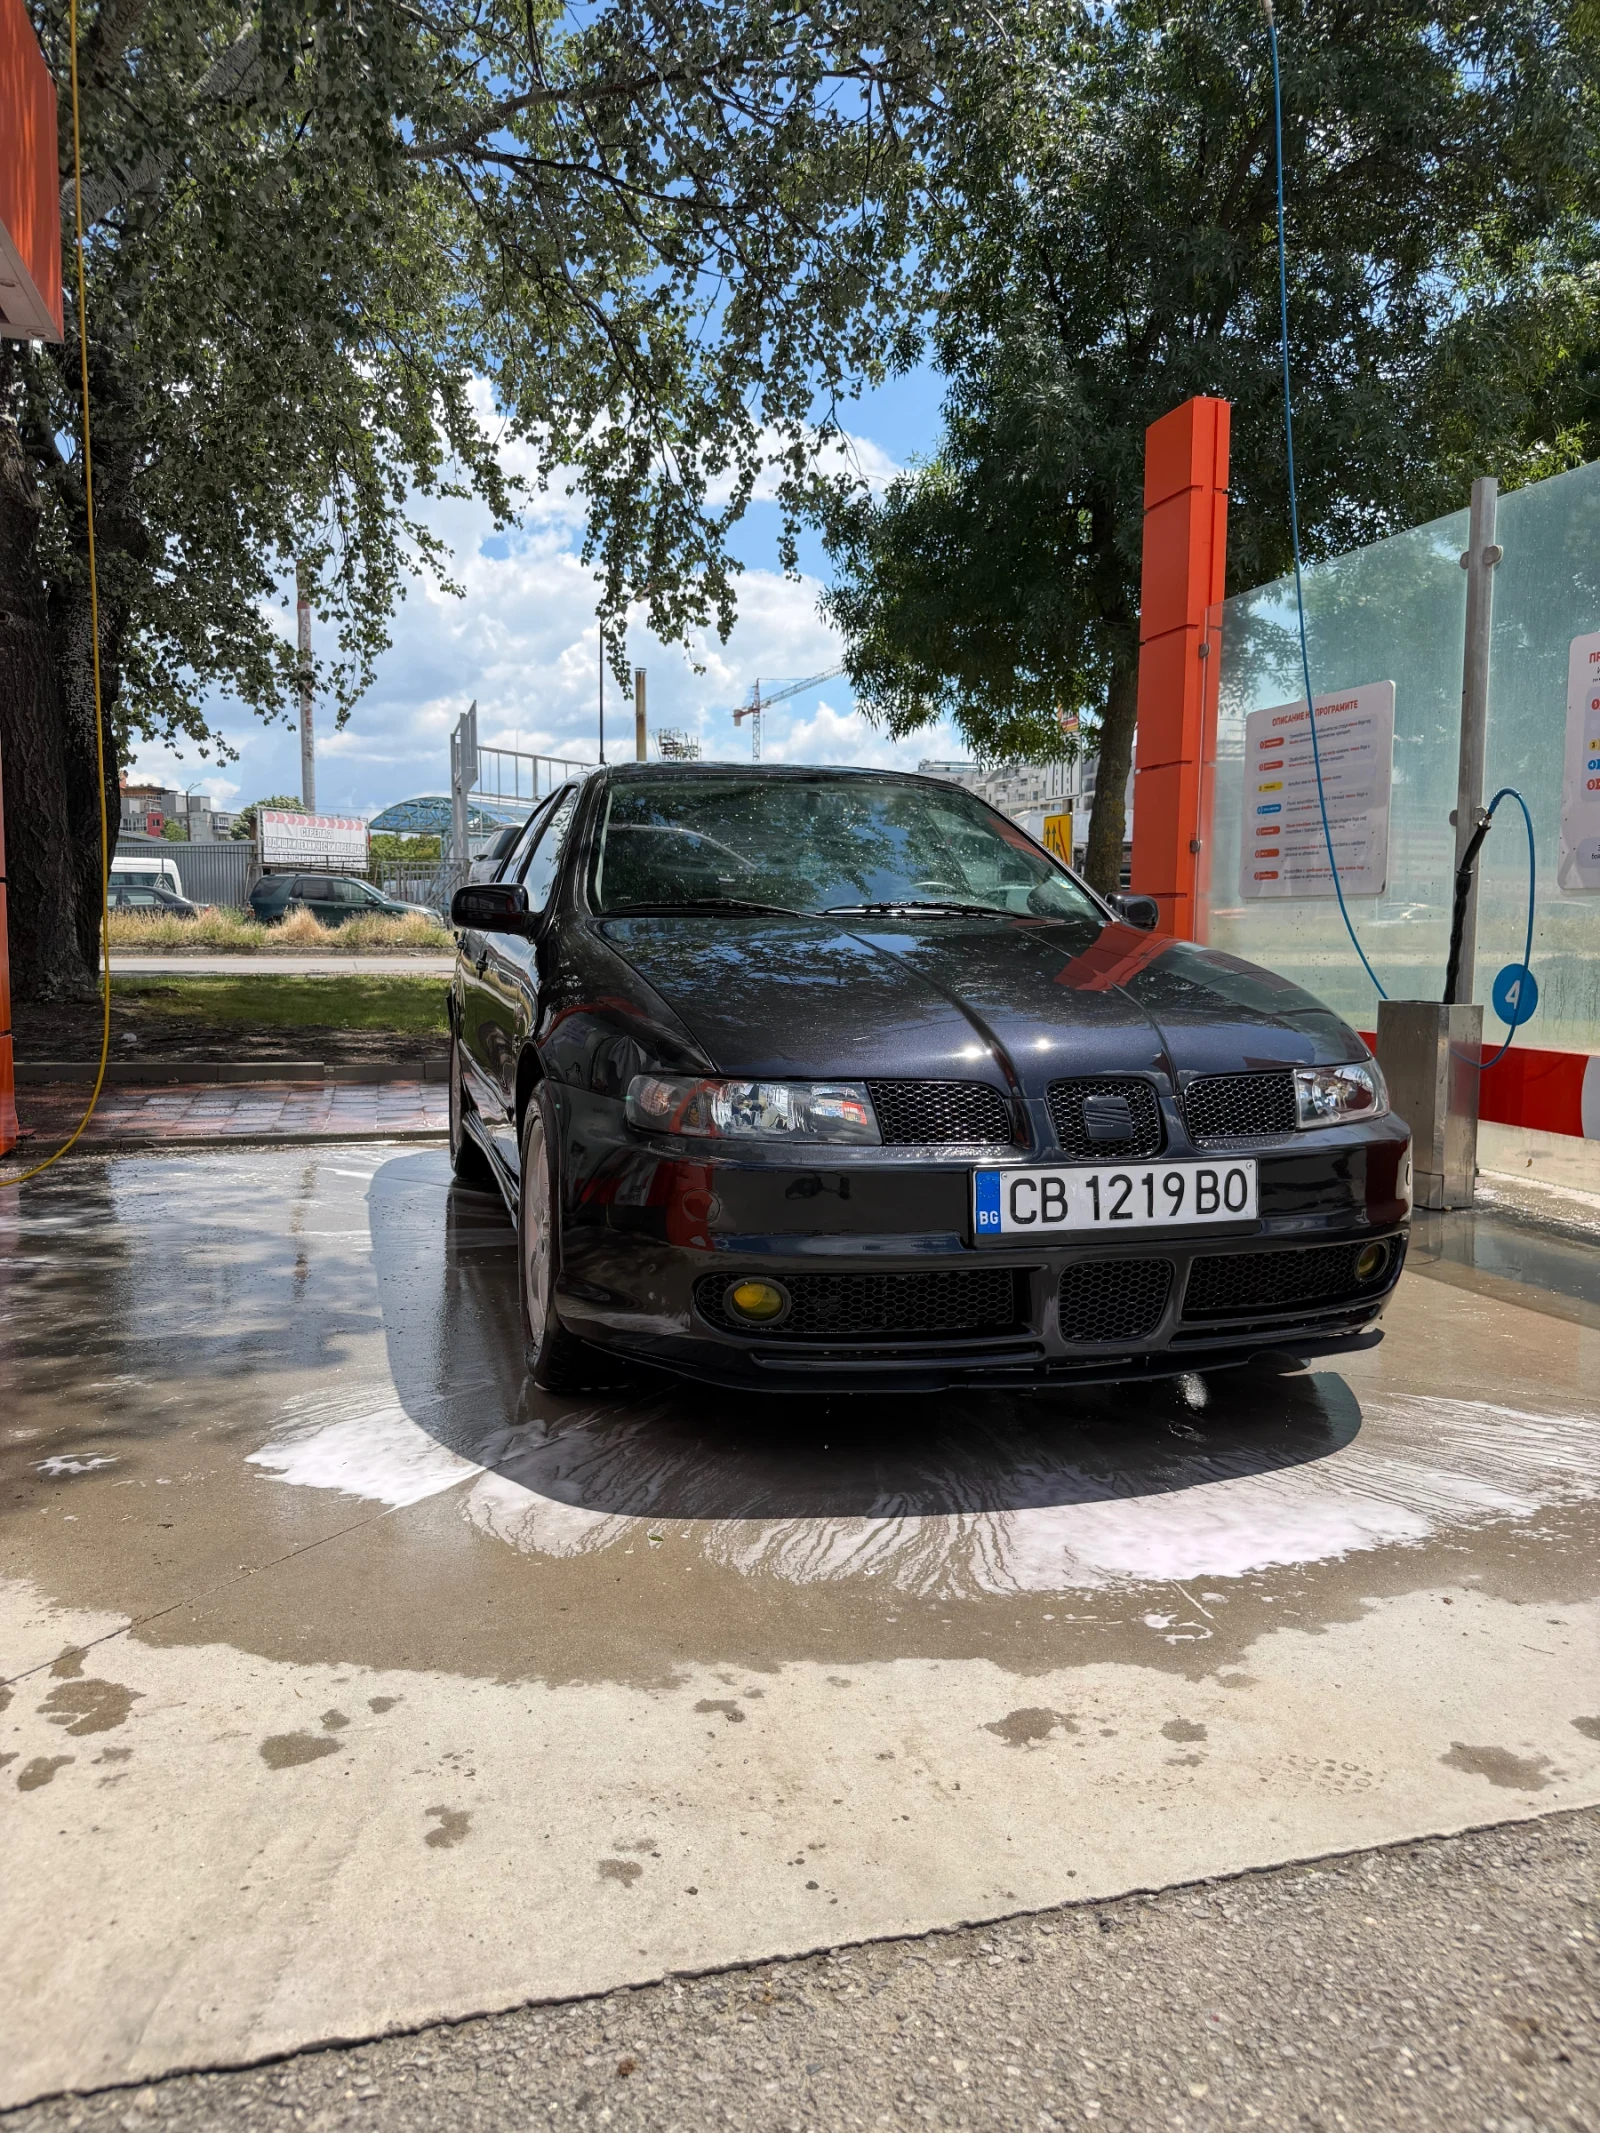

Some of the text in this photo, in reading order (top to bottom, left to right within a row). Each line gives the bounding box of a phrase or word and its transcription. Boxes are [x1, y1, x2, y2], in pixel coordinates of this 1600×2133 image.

[1271, 711, 1304, 727] ОПИСАНИЕ
[1315, 699, 1359, 717] ПРОГРАМИТЕ
[300, 827, 333, 839] СТРЕЛА 2
[264, 837, 297, 849] ГОДИШНИ
[297, 839, 337, 852] ТЕХНИЧЕСКИ
[1504, 979, 1521, 1010] 4
[1009, 1177, 1069, 1225] CB
[1086, 1171, 1185, 1221] 1219
[979, 1210, 999, 1225] BG
